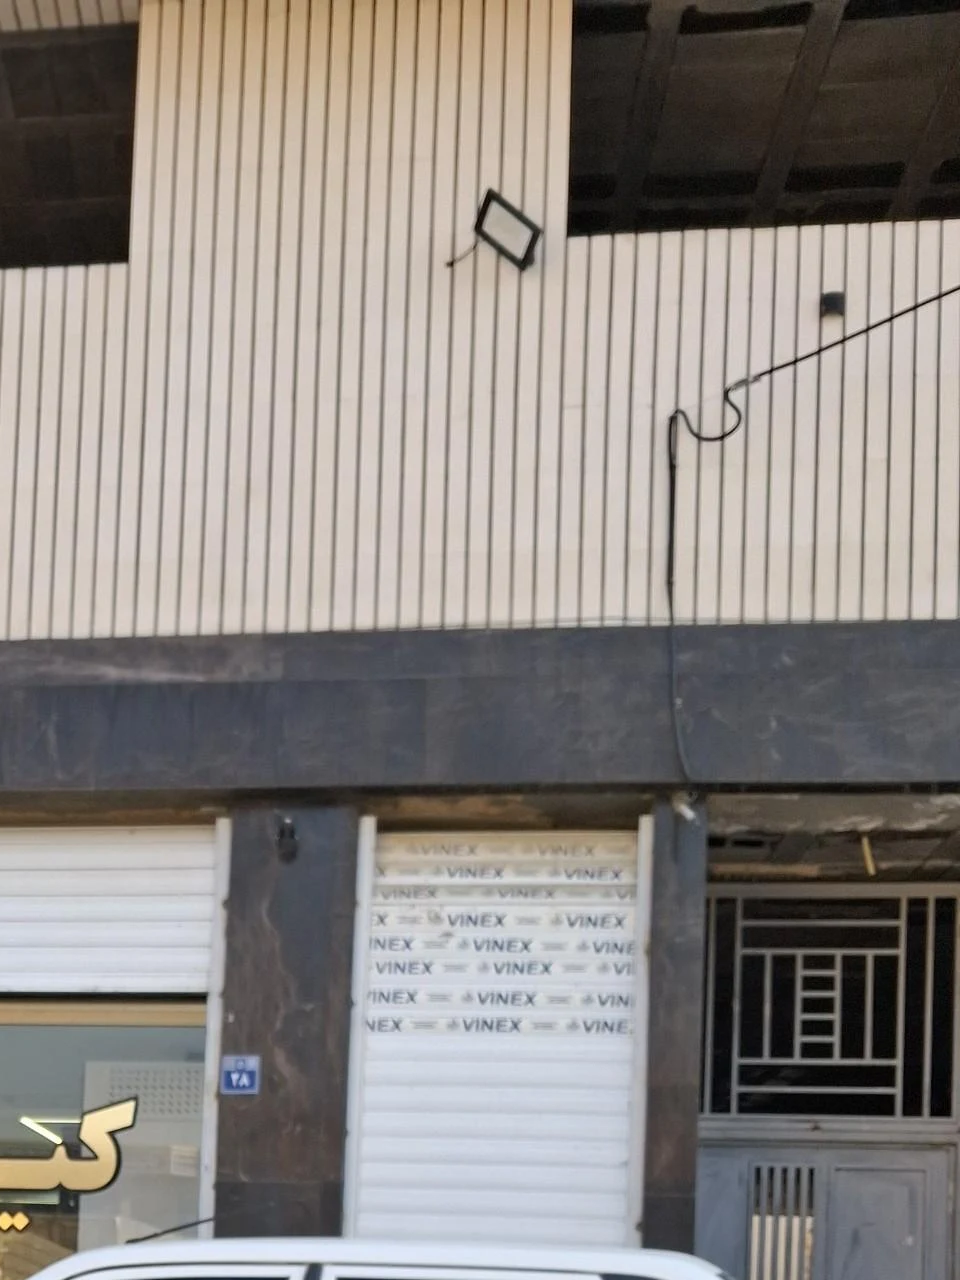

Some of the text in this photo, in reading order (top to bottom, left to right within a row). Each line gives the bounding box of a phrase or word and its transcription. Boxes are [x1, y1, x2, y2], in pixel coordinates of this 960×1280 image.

[419, 844, 596, 857] VINEX VINEX
[445, 866, 623, 881] VINEX VINEX
[380, 886, 557, 900] VINEX VINEX
[446, 913, 627, 929] VINEX VINEX
[472, 938, 533, 953] VINEX
[375, 961, 553, 976] VINEX VINEX
[476, 991, 537, 1006] VINEX
[462, 1018, 523, 1033] VINEX
